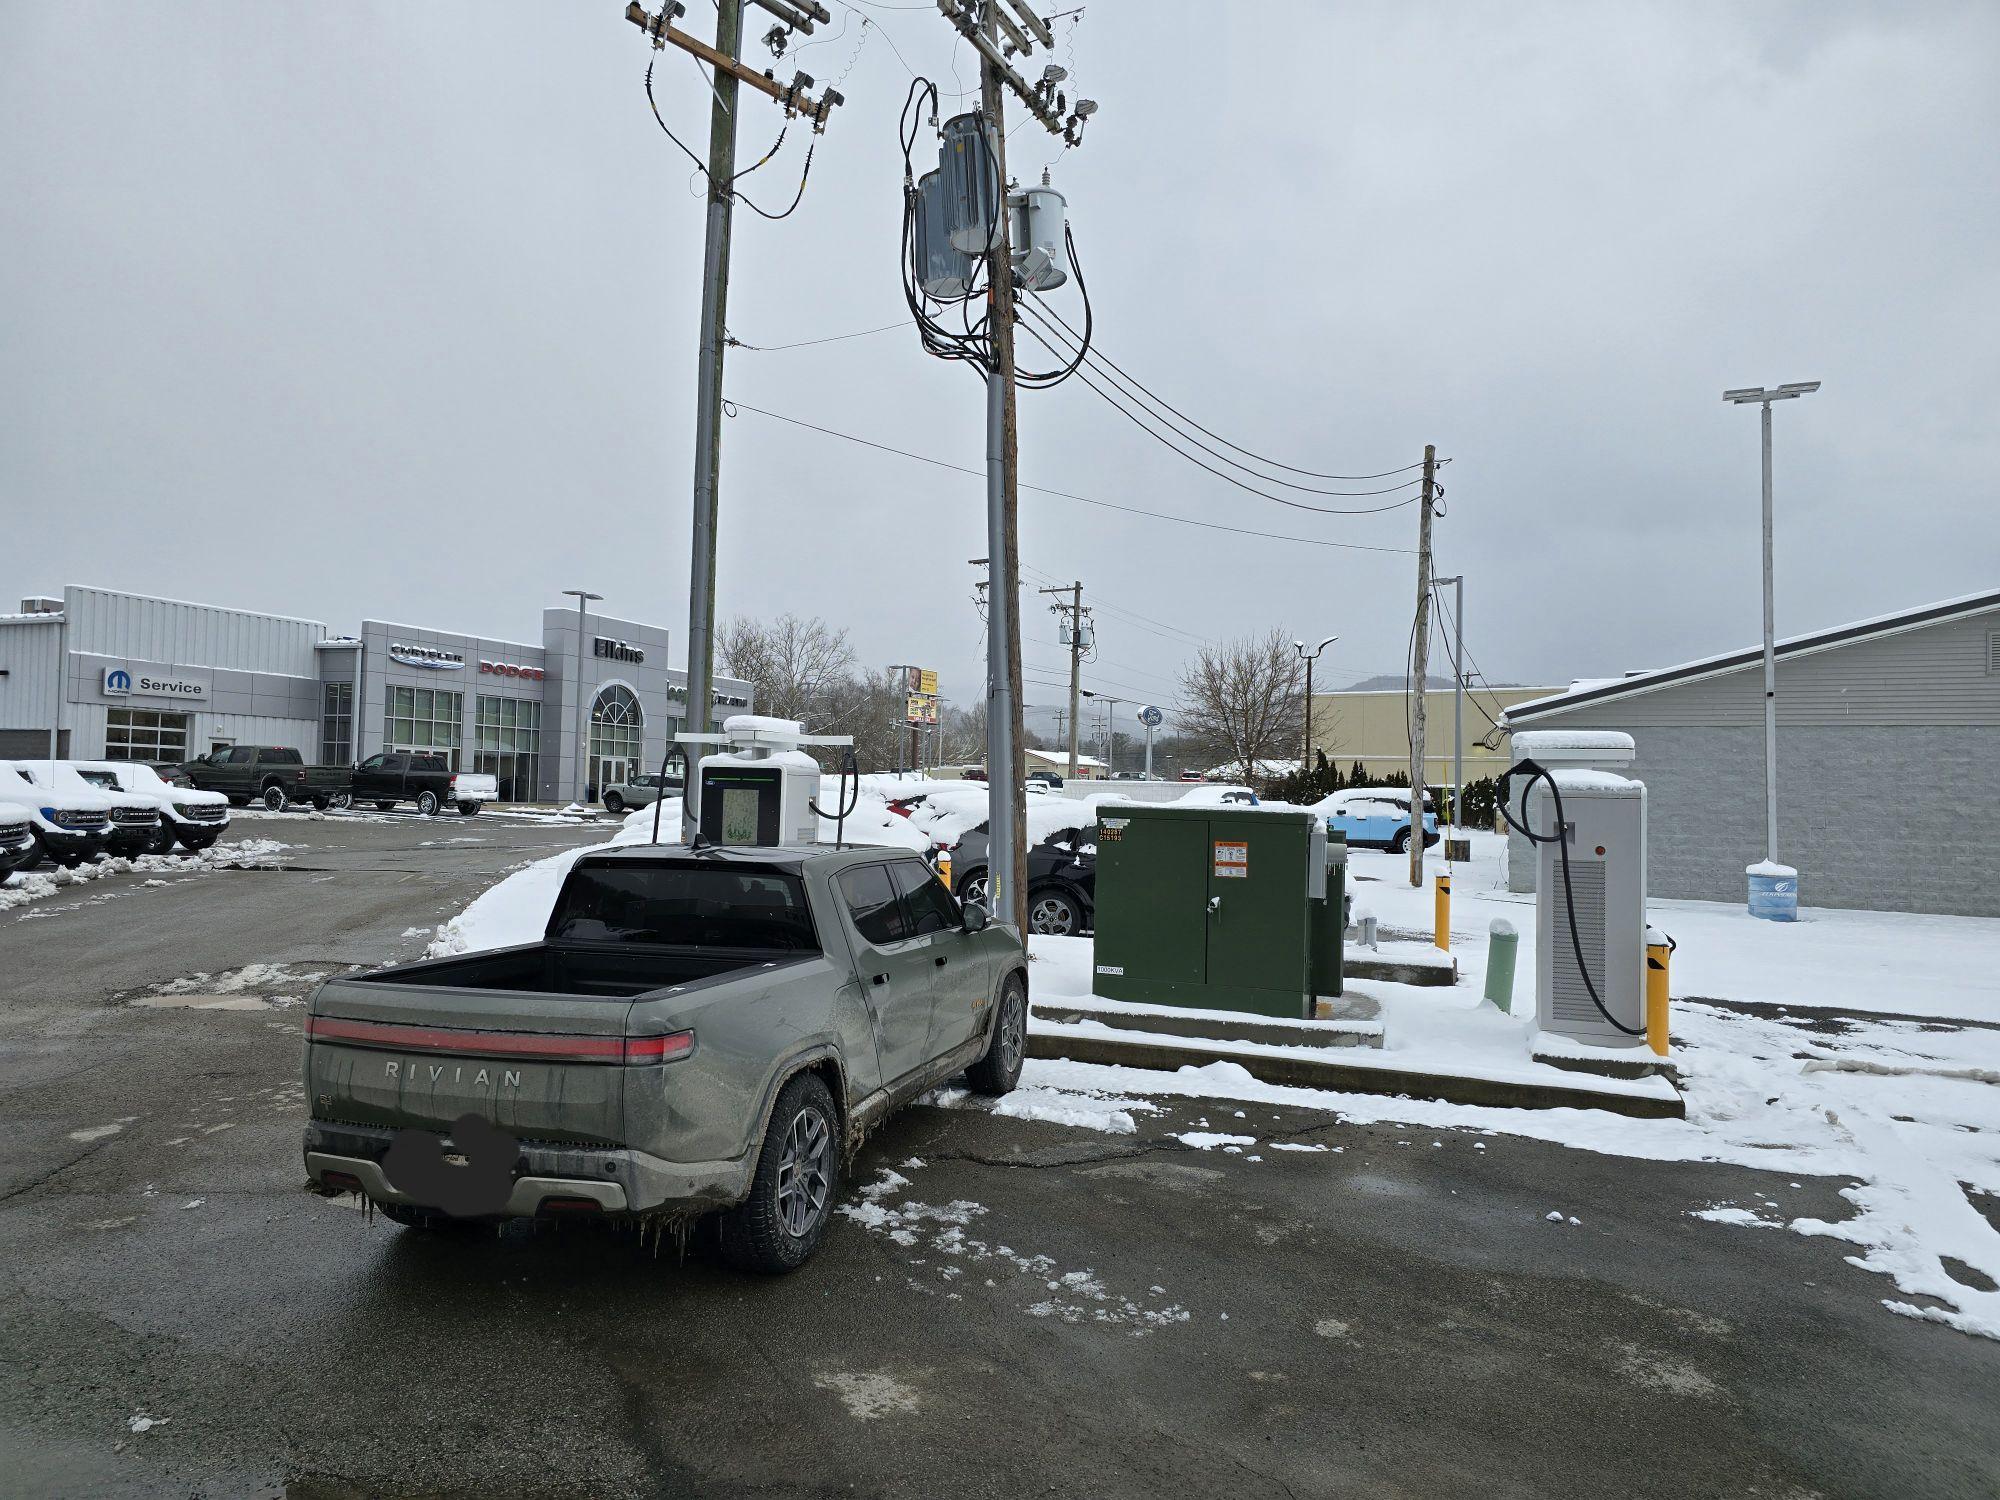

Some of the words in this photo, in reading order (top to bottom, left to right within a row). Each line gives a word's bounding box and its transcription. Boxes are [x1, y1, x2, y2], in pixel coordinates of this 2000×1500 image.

[391, 645, 463, 662] CHRYSLER
[594, 636, 645, 664] Elkins
[479, 661, 545, 681] DODGE
[140, 678, 202, 694] Service
[384, 1061, 521, 1087] RIVIAN
